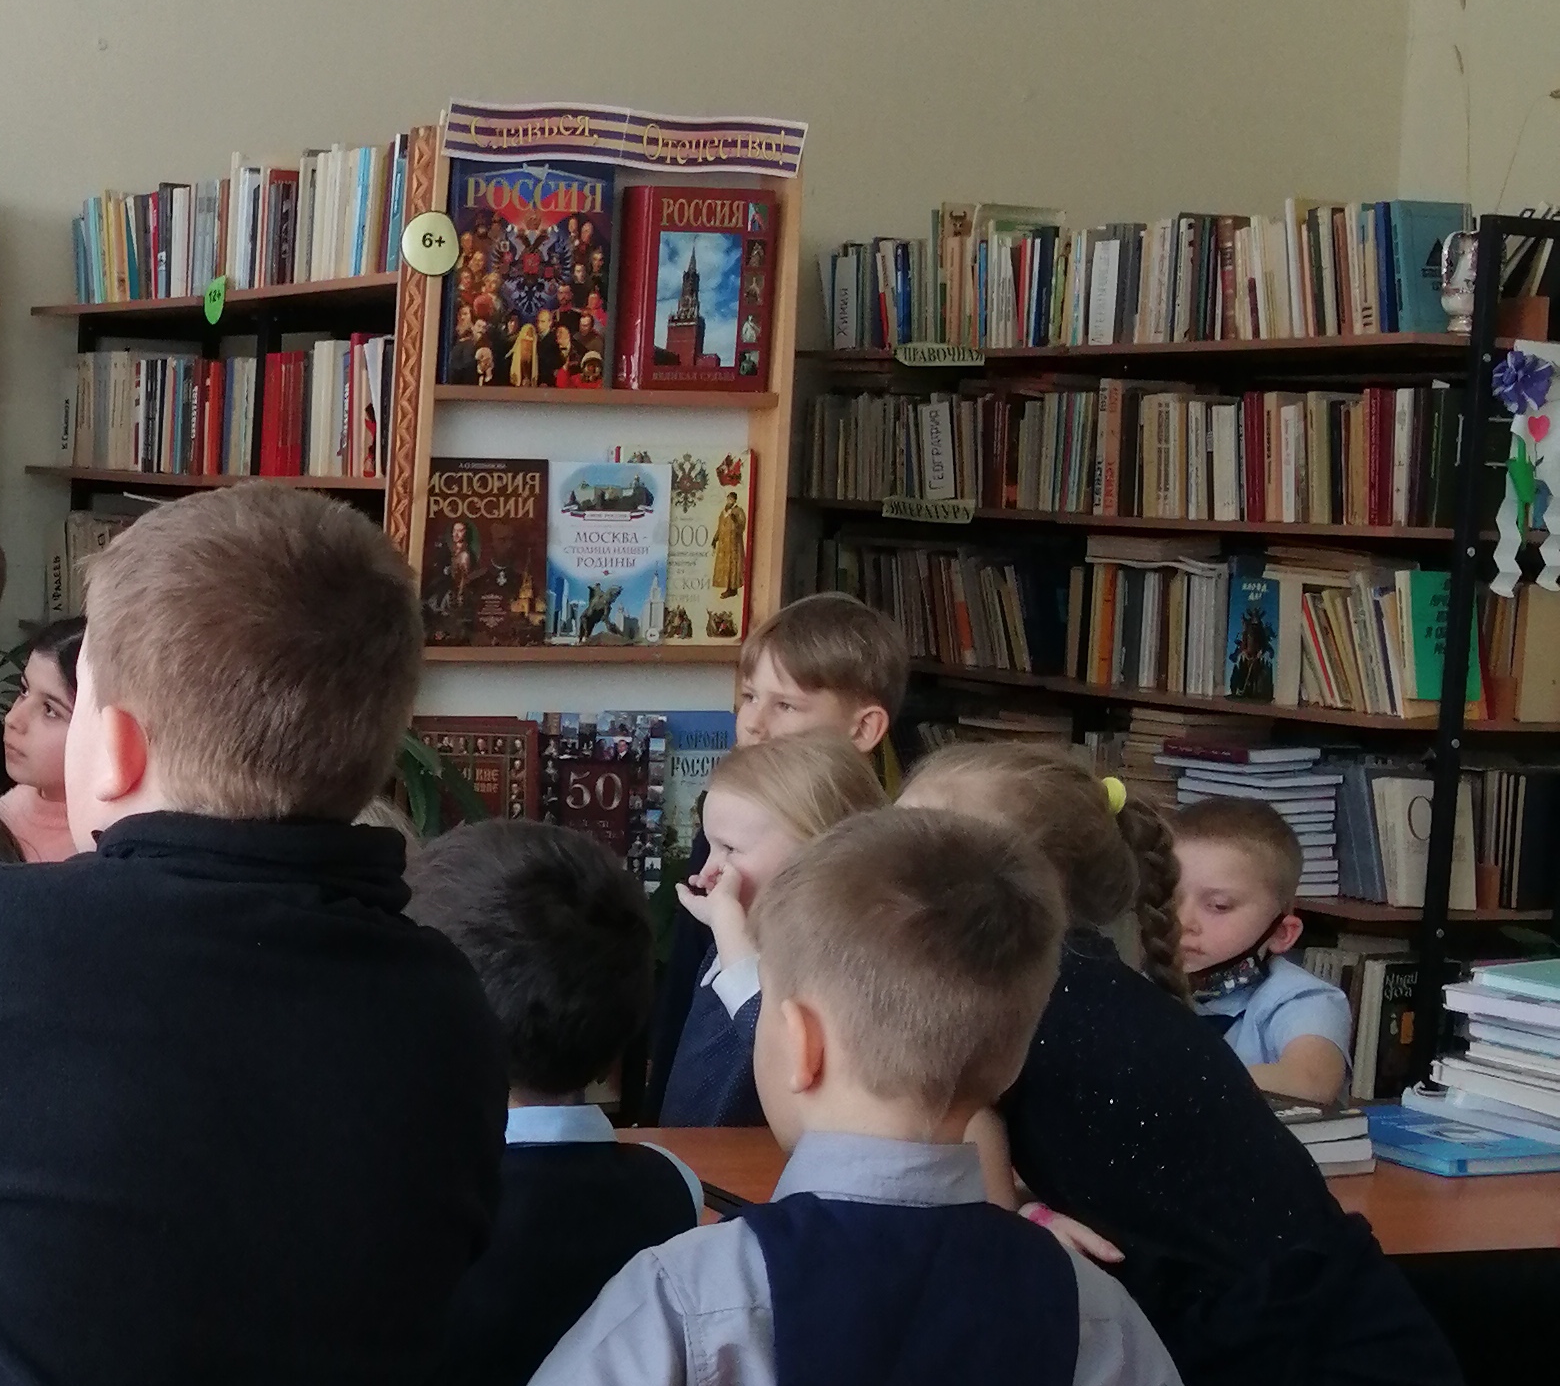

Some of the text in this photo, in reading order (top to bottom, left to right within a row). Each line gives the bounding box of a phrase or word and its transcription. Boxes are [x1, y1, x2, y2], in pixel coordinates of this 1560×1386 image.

[469, 113, 786, 165] Славься, Отечество!
[463, 176, 604, 213] РОССИЯ
[660, 197, 744, 228] РОССИЯ
[421, 232, 446, 248] 6+
[427, 471, 541, 496] ИСТОРИЯ
[428, 496, 535, 519] РОССИИ
[573, 530, 639, 544] МОСКВА
[668, 524, 709, 547] 000
[576, 556, 636, 569] РОДИНЫ
[670, 756, 721, 777] РОСС
[565, 770, 623, 811] 50
